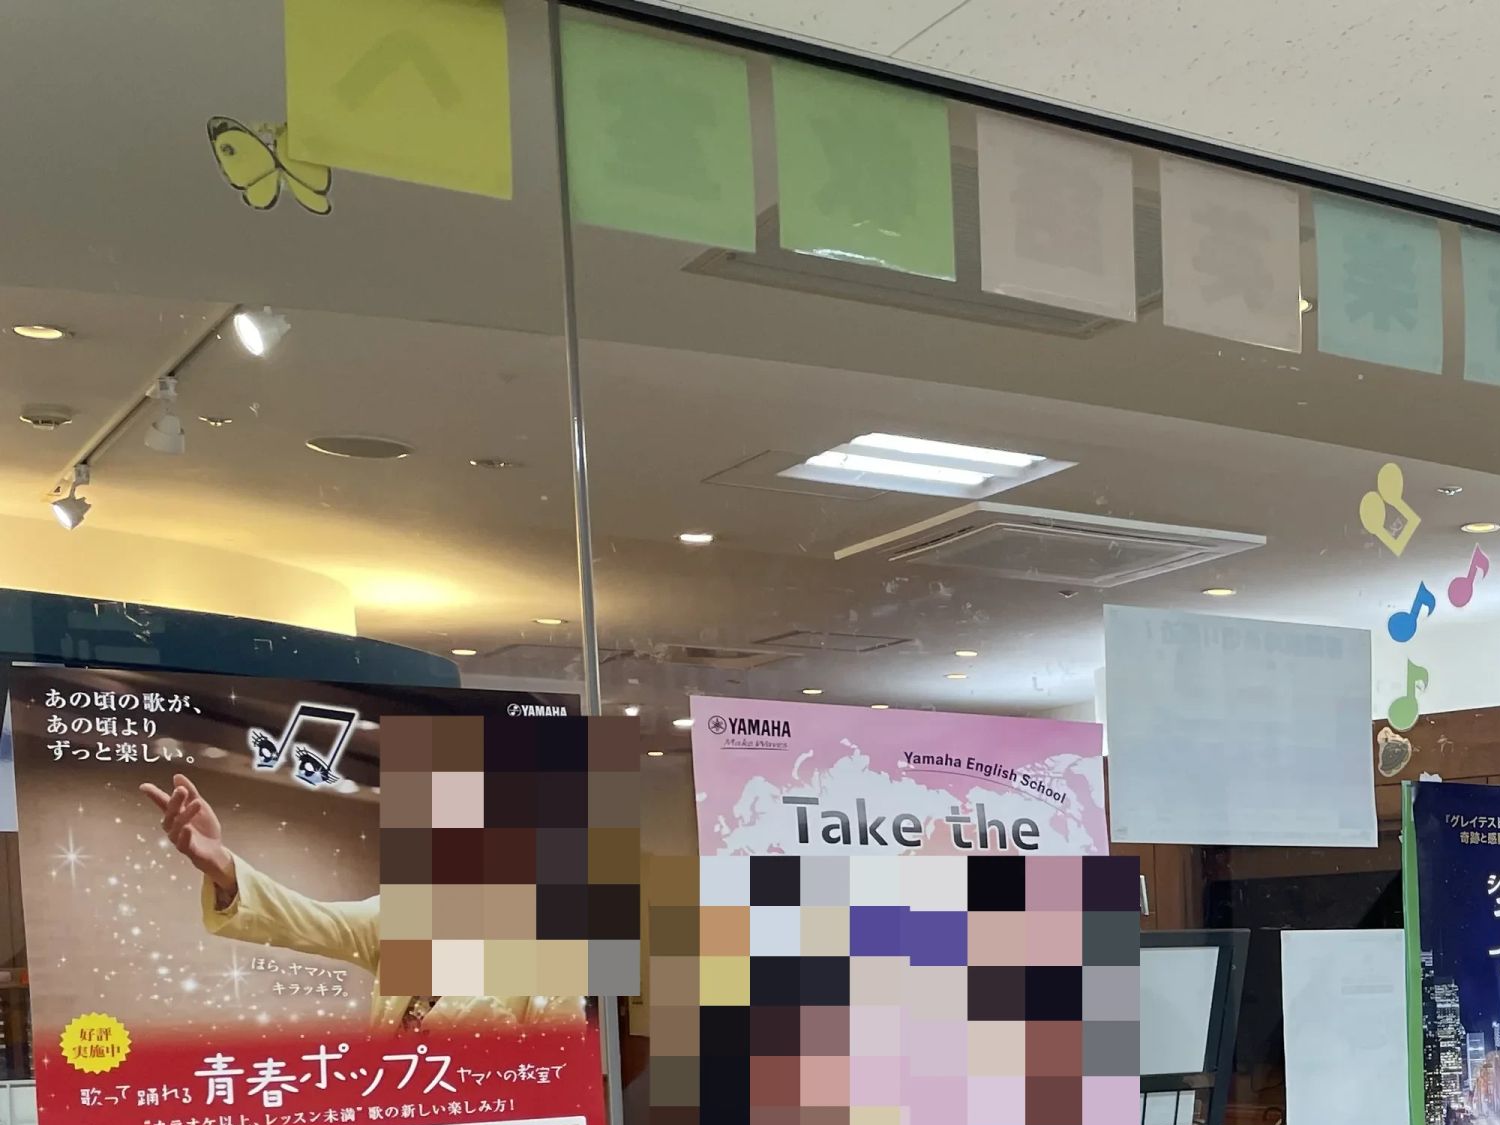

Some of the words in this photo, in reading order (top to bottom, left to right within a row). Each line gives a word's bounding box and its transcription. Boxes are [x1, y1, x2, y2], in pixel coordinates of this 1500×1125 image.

[44, 688, 202, 716] あの頃の歌が、
[521, 704, 567, 717] YAMAHA
[46, 714, 158, 739] あの頃より
[728, 717, 791, 738] YAMAHA
[47, 739, 198, 764] ずっと楽しい。
[723, 738, 752, 749] Make
[903, 751, 962, 769] Yamaha
[965, 757, 1018, 783] English
[1020, 773, 1067, 804] School
[782, 796, 923, 849] Take
[945, 803, 1041, 852] the
[251, 957, 348, 983] ほら、ヤマハで
[79, 1026, 113, 1044] 好評
[72, 1043, 123, 1061] 実施中
[193, 1043, 458, 1109] 青春ポップス
[457, 1062, 566, 1086] ヤマハの教室で
